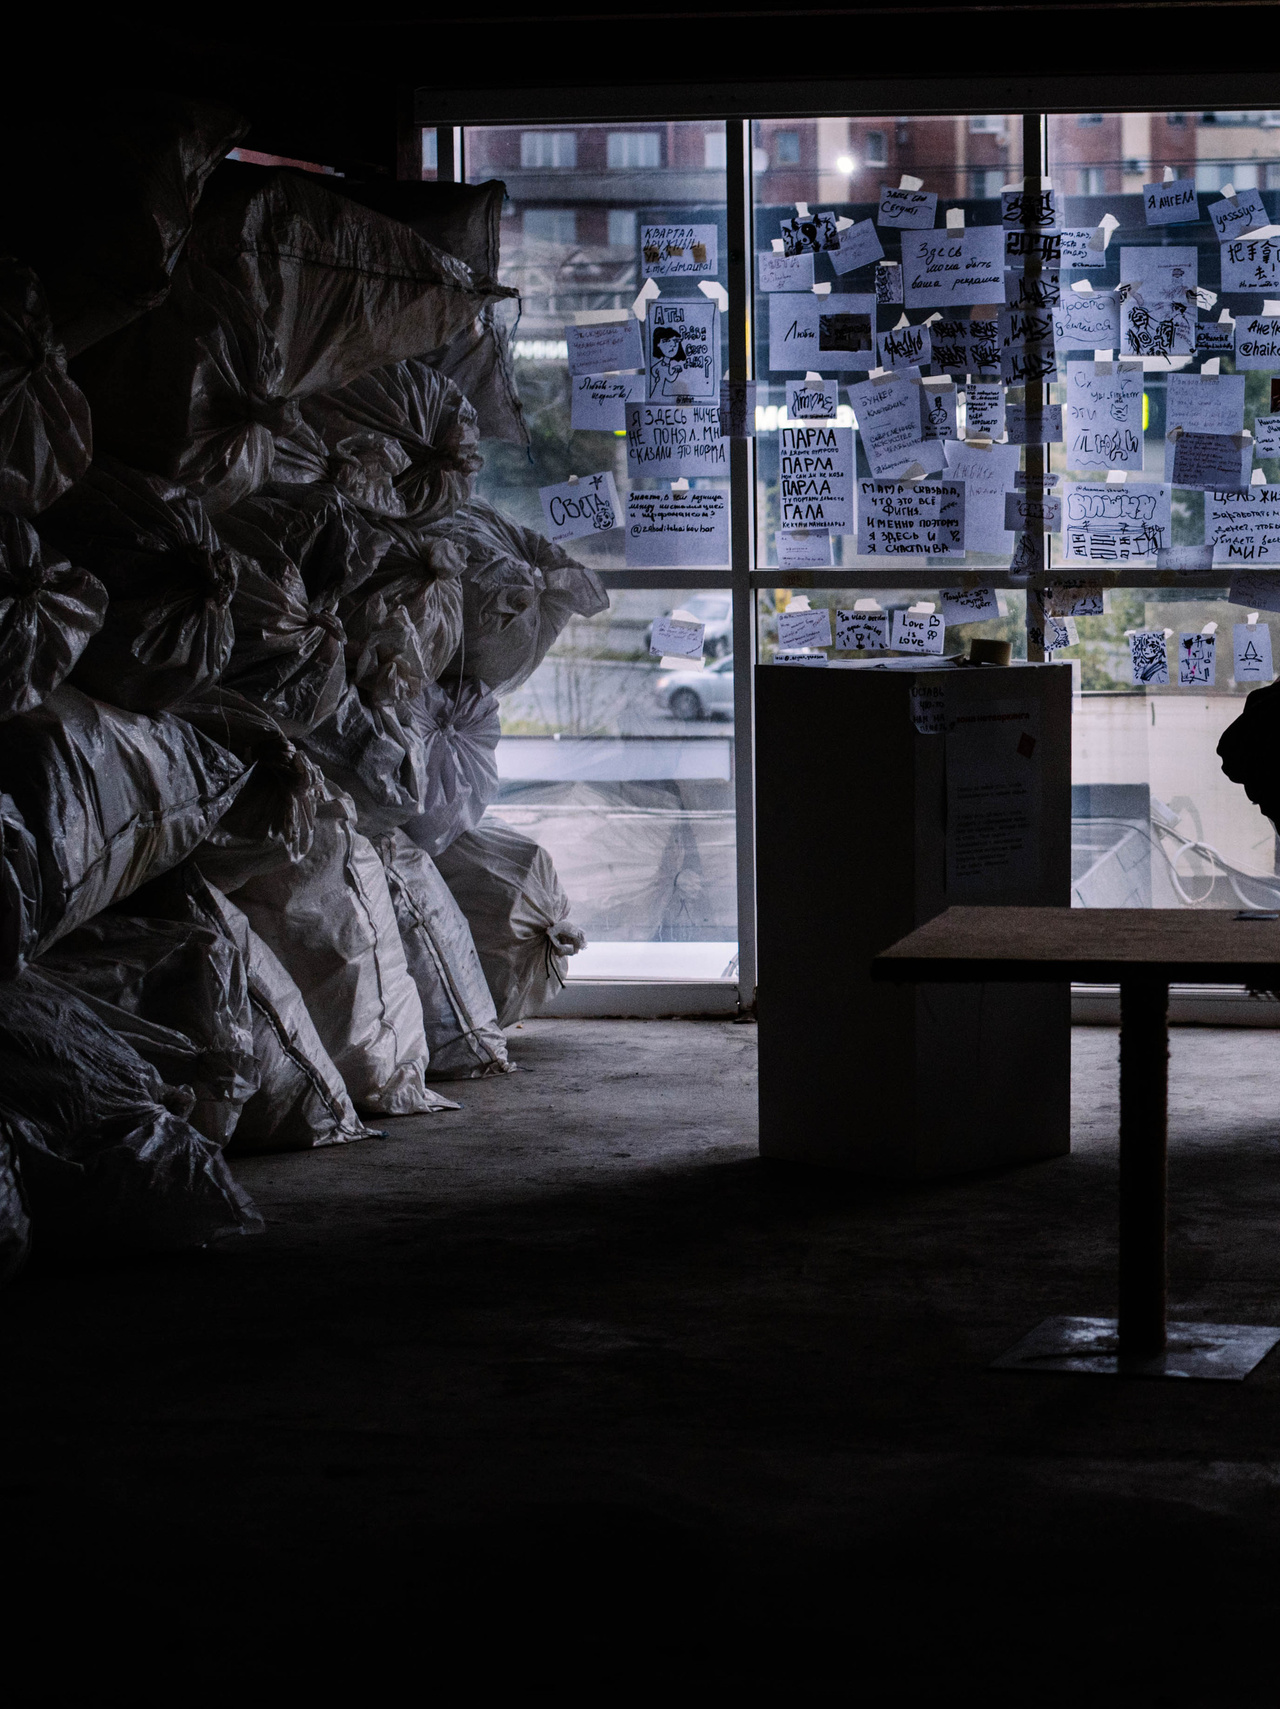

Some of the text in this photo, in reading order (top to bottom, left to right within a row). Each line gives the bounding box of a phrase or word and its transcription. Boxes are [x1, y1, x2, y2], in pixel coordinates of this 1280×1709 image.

[916, 242, 962, 265] Здесь
[632, 407, 721, 426] Я ЗДЕСЬ НИЧЕГ
[629, 428, 646, 446] НЕ
[702, 428, 720, 443] МН
[782, 428, 837, 449] ПАРЛА
[629, 448, 672, 465] СКАЗАЛИ
[782, 457, 834, 475] ПАРЛА
[782, 480, 831, 497] ПАРЛА
[862, 482, 905, 495] МАМА
[784, 504, 824, 520] ГАЛА
[868, 533, 876, 541] Я
[882, 532, 919, 543] ЗДЕСЬ
[1228, 545, 1269, 560] МИР
[902, 614, 924, 630] Love
